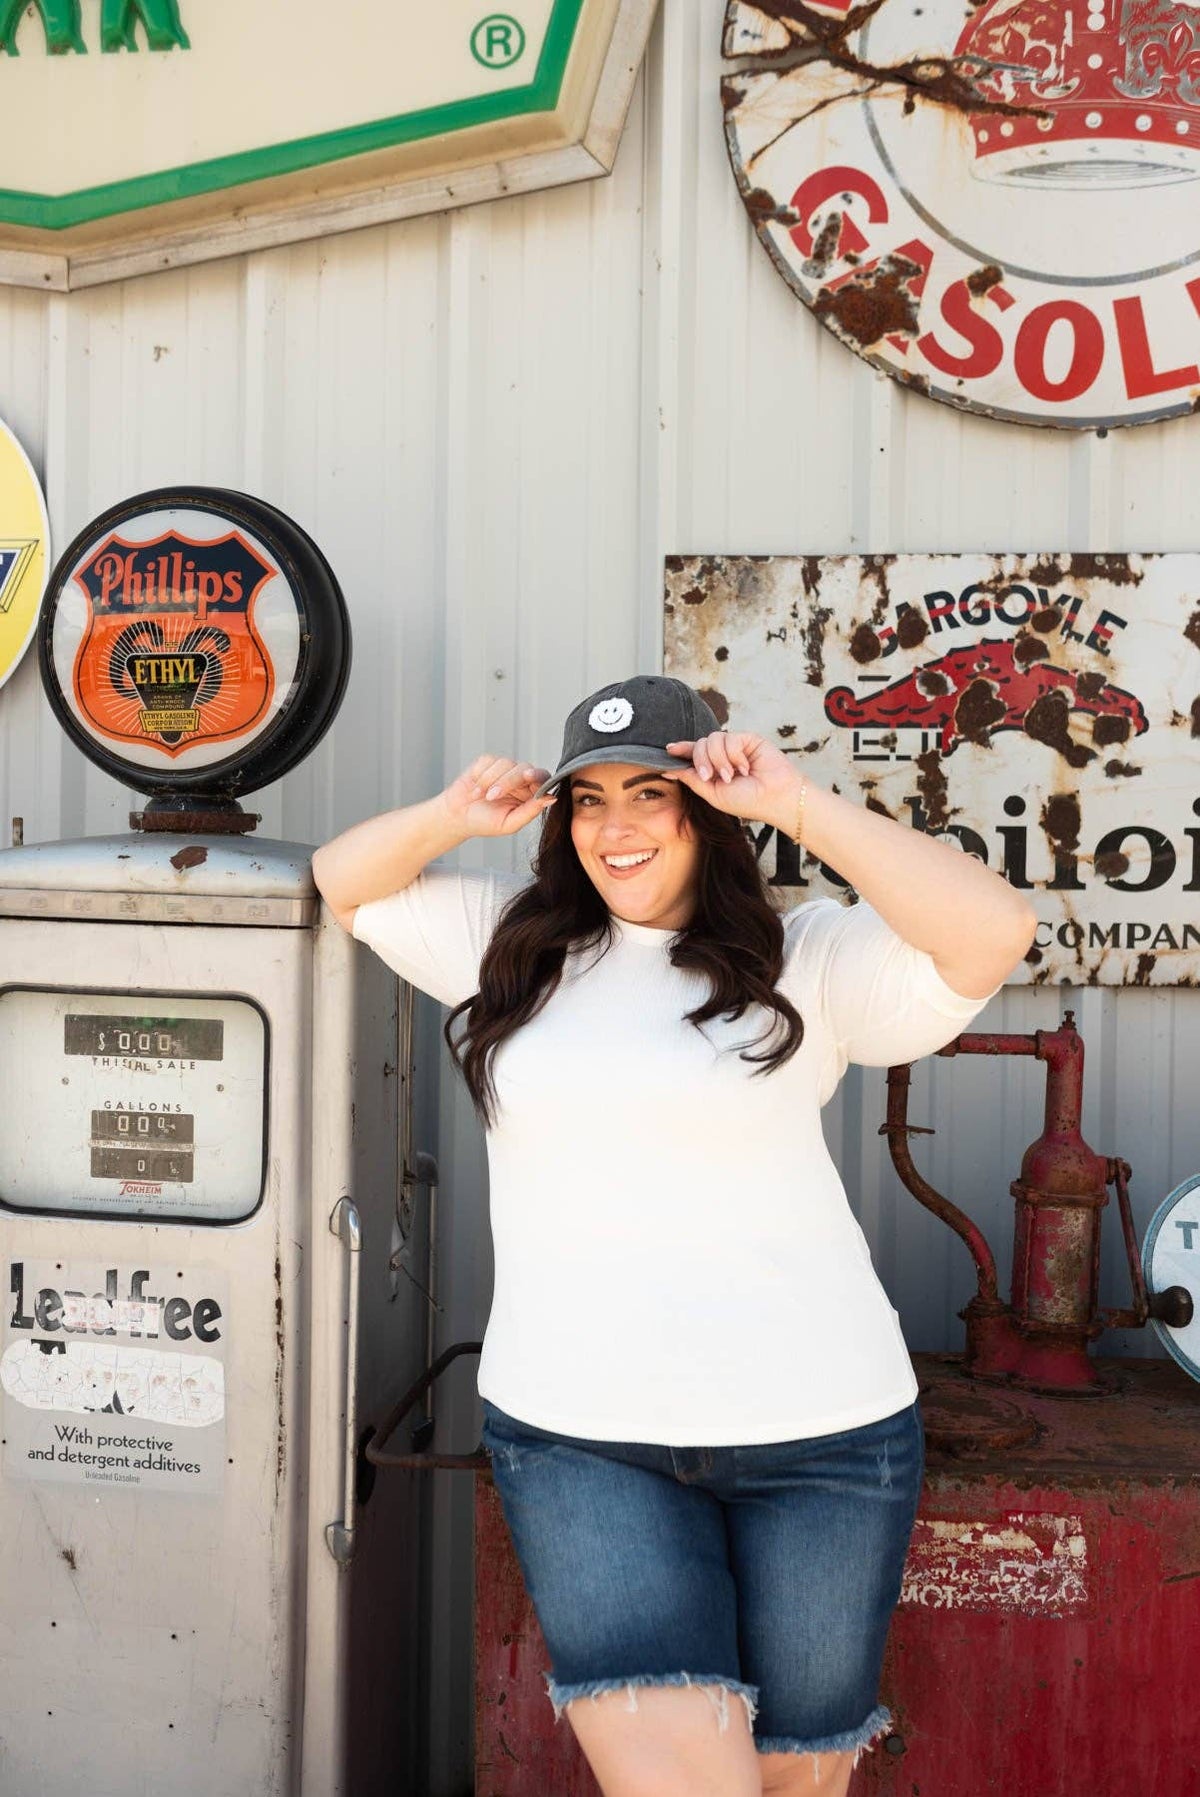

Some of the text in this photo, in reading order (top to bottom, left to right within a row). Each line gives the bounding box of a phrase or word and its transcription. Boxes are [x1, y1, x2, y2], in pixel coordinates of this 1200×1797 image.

[94, 551, 244, 620] Phillips
[134, 658, 200, 684] ETHYL
[157, 1060, 196, 1070] SALE
[104, 1100, 182, 1113] GALLONS
[119, 1180, 163, 1195] TOKHEIM
[1175, 1221, 1199, 1250] T
[54, 1425, 173, 1451] With protective
[28, 1445, 201, 1473] and detergent additives
